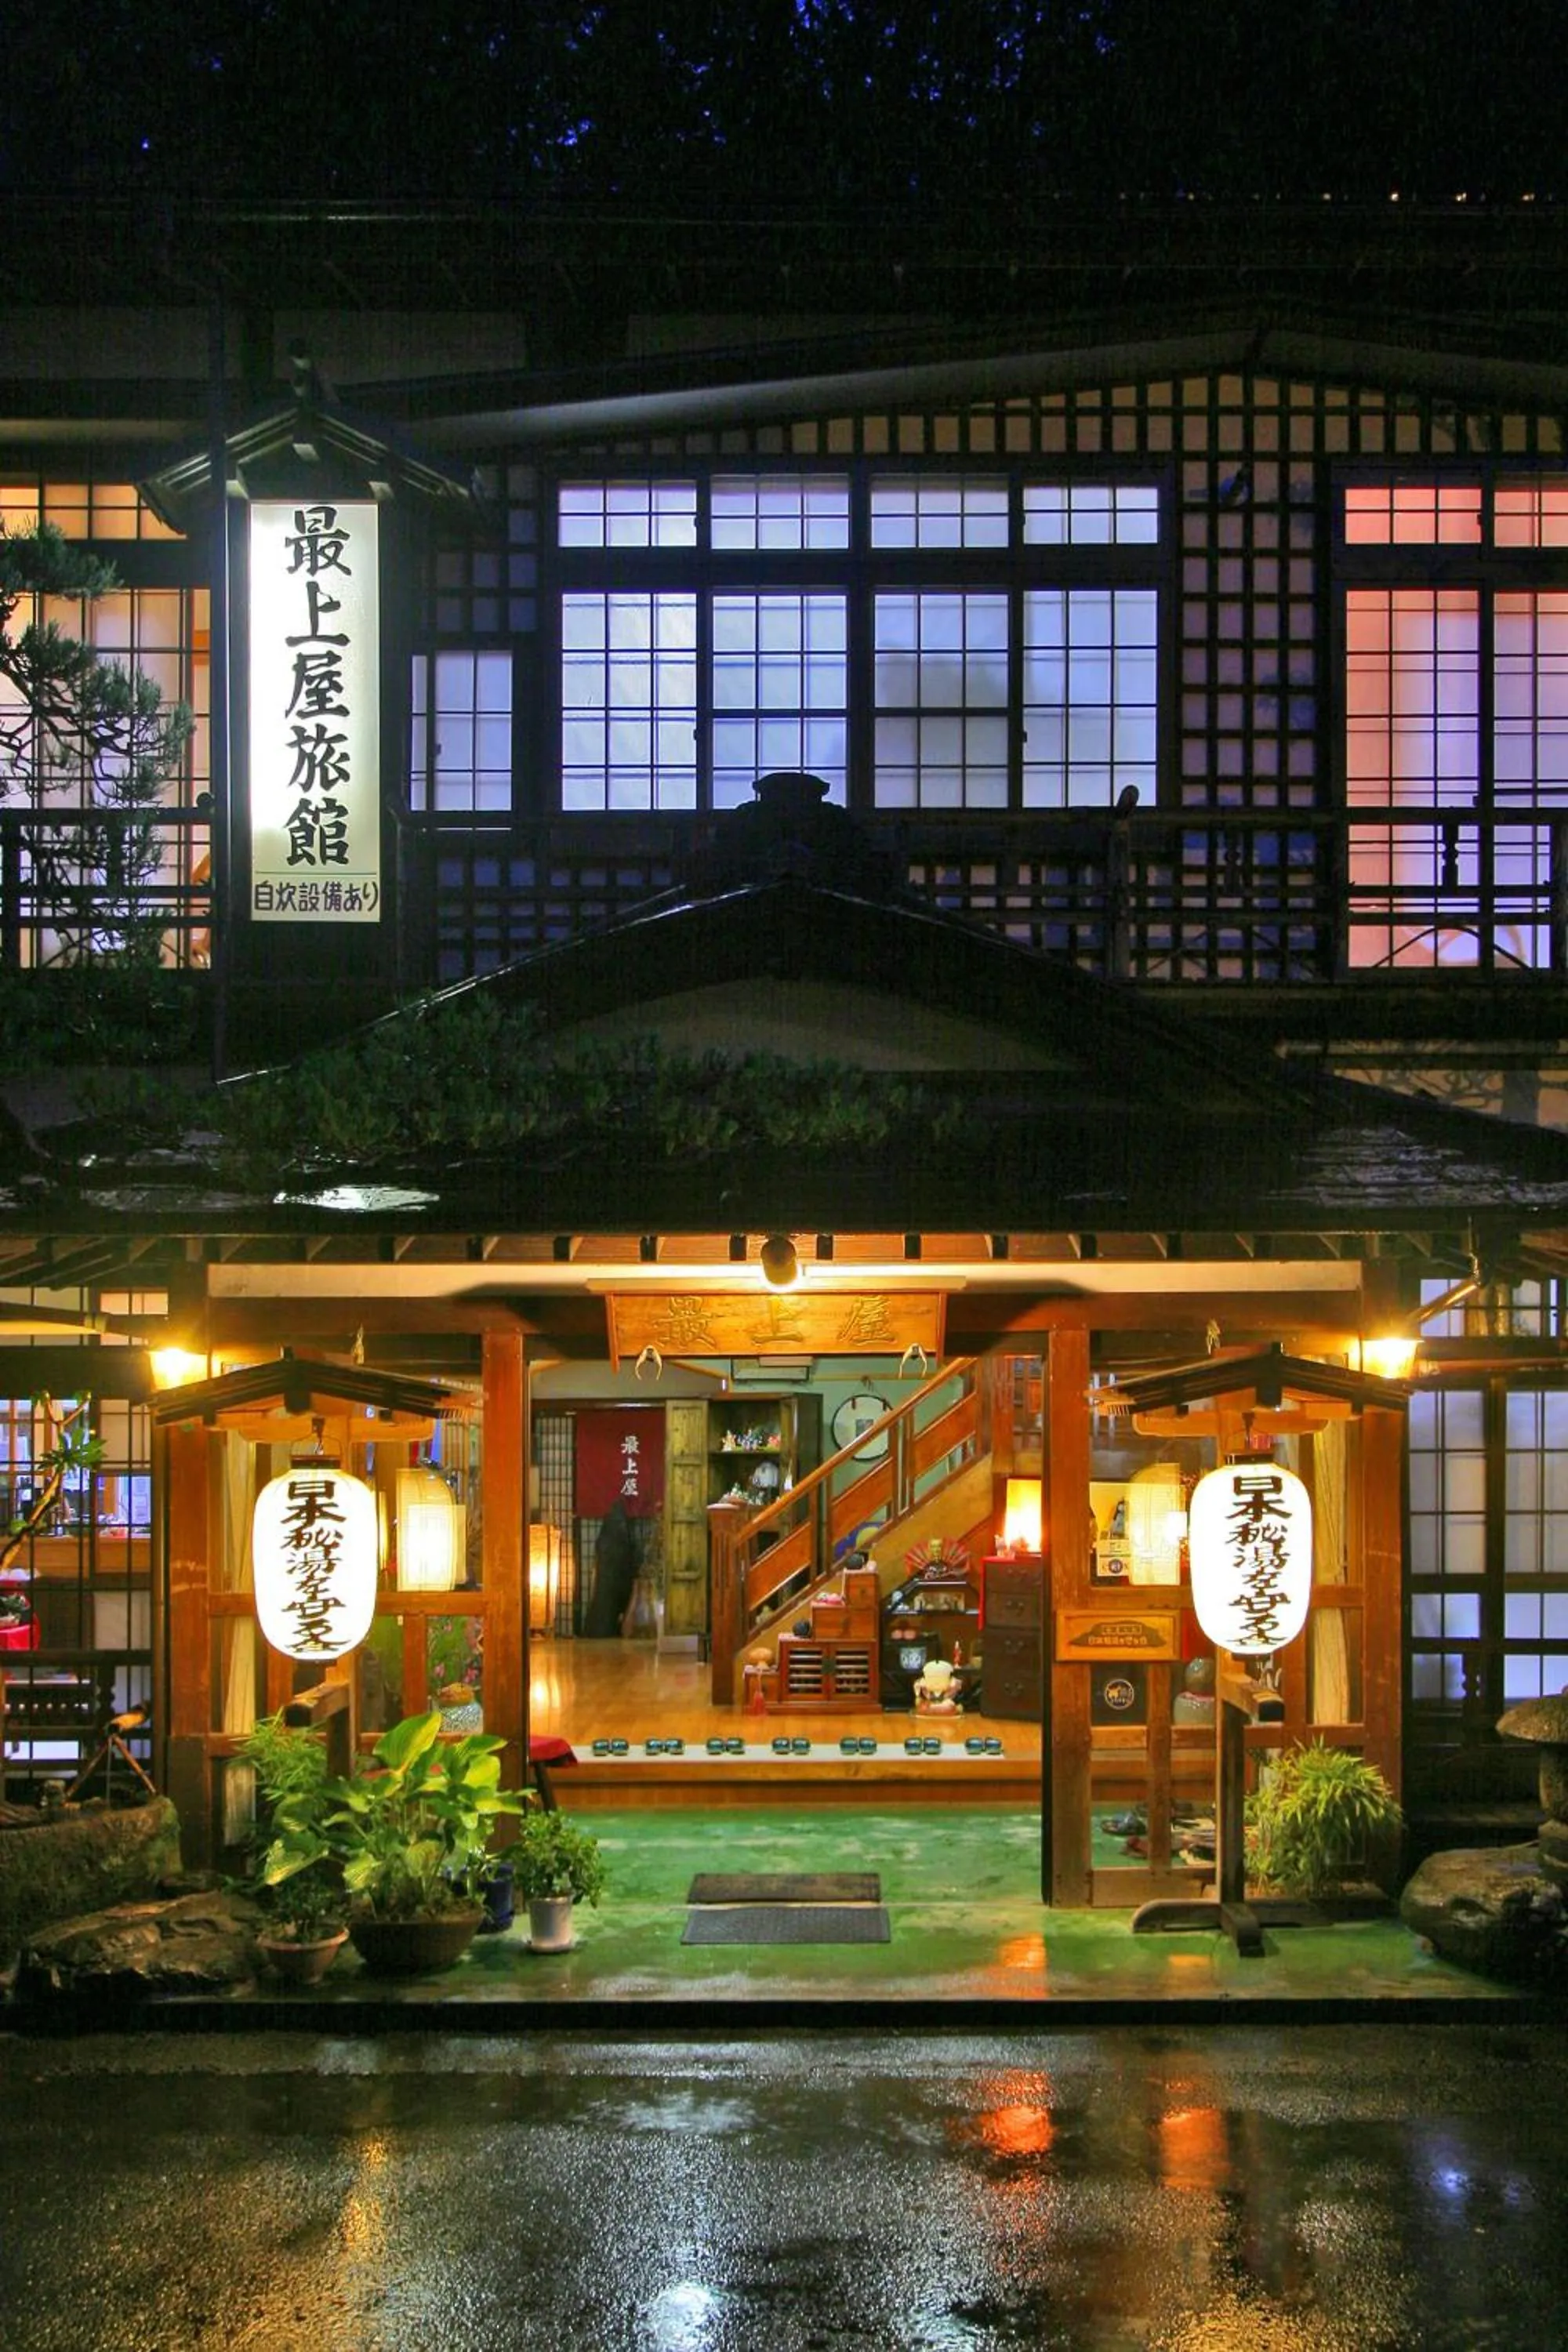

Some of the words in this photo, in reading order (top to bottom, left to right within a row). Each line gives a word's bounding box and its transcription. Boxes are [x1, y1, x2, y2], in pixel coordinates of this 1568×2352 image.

[285, 506, 351, 867] 最上屋旅館
[255, 880, 379, 912] 自炊設備あり
[652, 1294, 898, 1349] 最上屋
[620, 1436, 641, 1497] 最上屋
[280, 1479, 351, 1653] 日本秘湯を守る会
[1225, 1475, 1293, 1646] 日本秘湯を守る会
